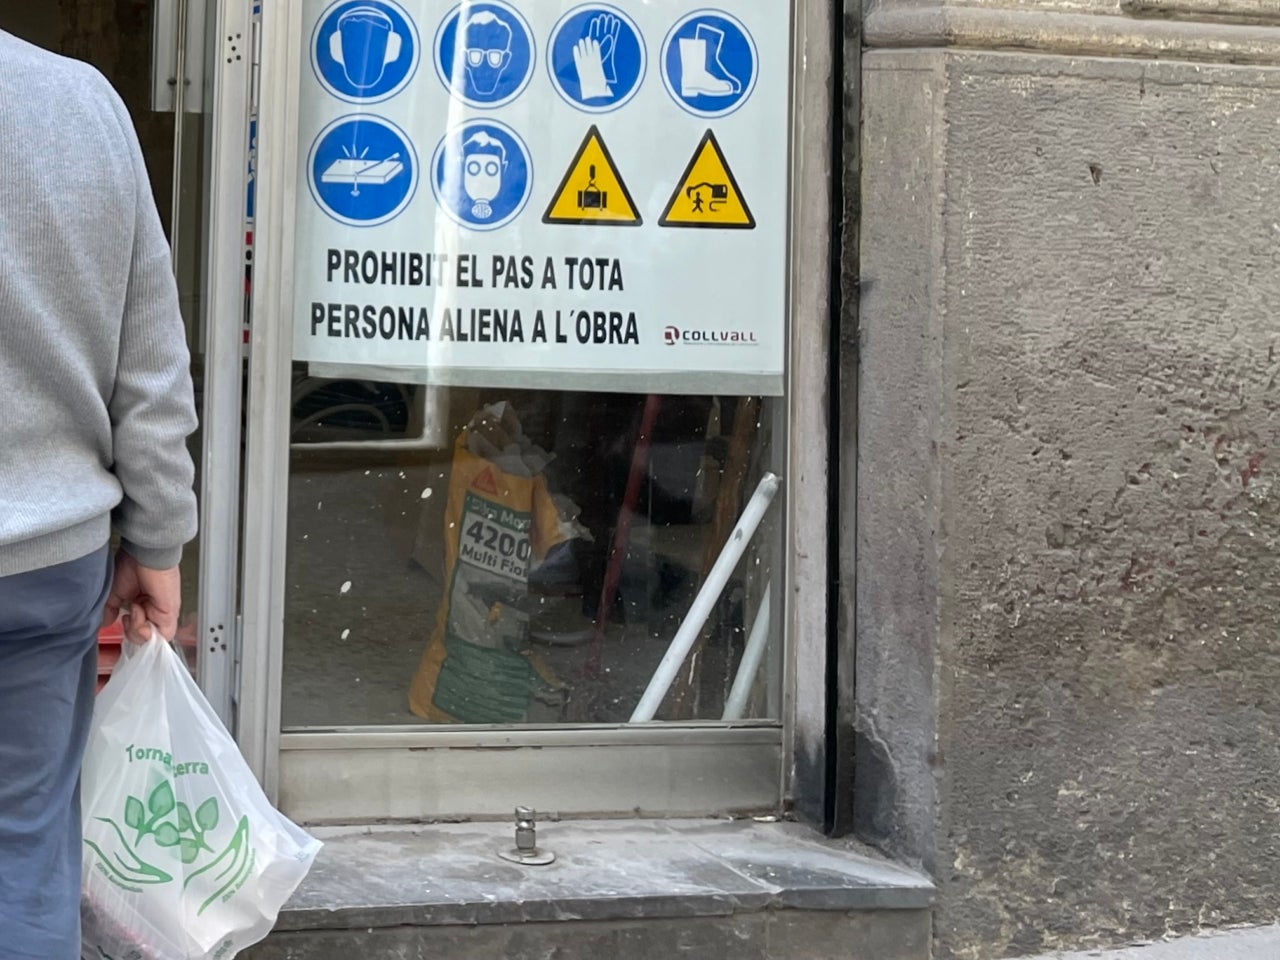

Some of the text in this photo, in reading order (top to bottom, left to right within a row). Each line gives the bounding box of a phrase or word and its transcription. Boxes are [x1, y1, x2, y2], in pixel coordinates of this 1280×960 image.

[327, 248, 624, 291] PROHIBIT EL PAS A TOTA
[311, 301, 430, 341] PERSONA
[439, 307, 524, 343] ALIENA
[531, 310, 547, 343] A
[461, 543, 498, 567] Multi
[466, 520, 531, 561] 4200
[126, 744, 172, 766] Torna
